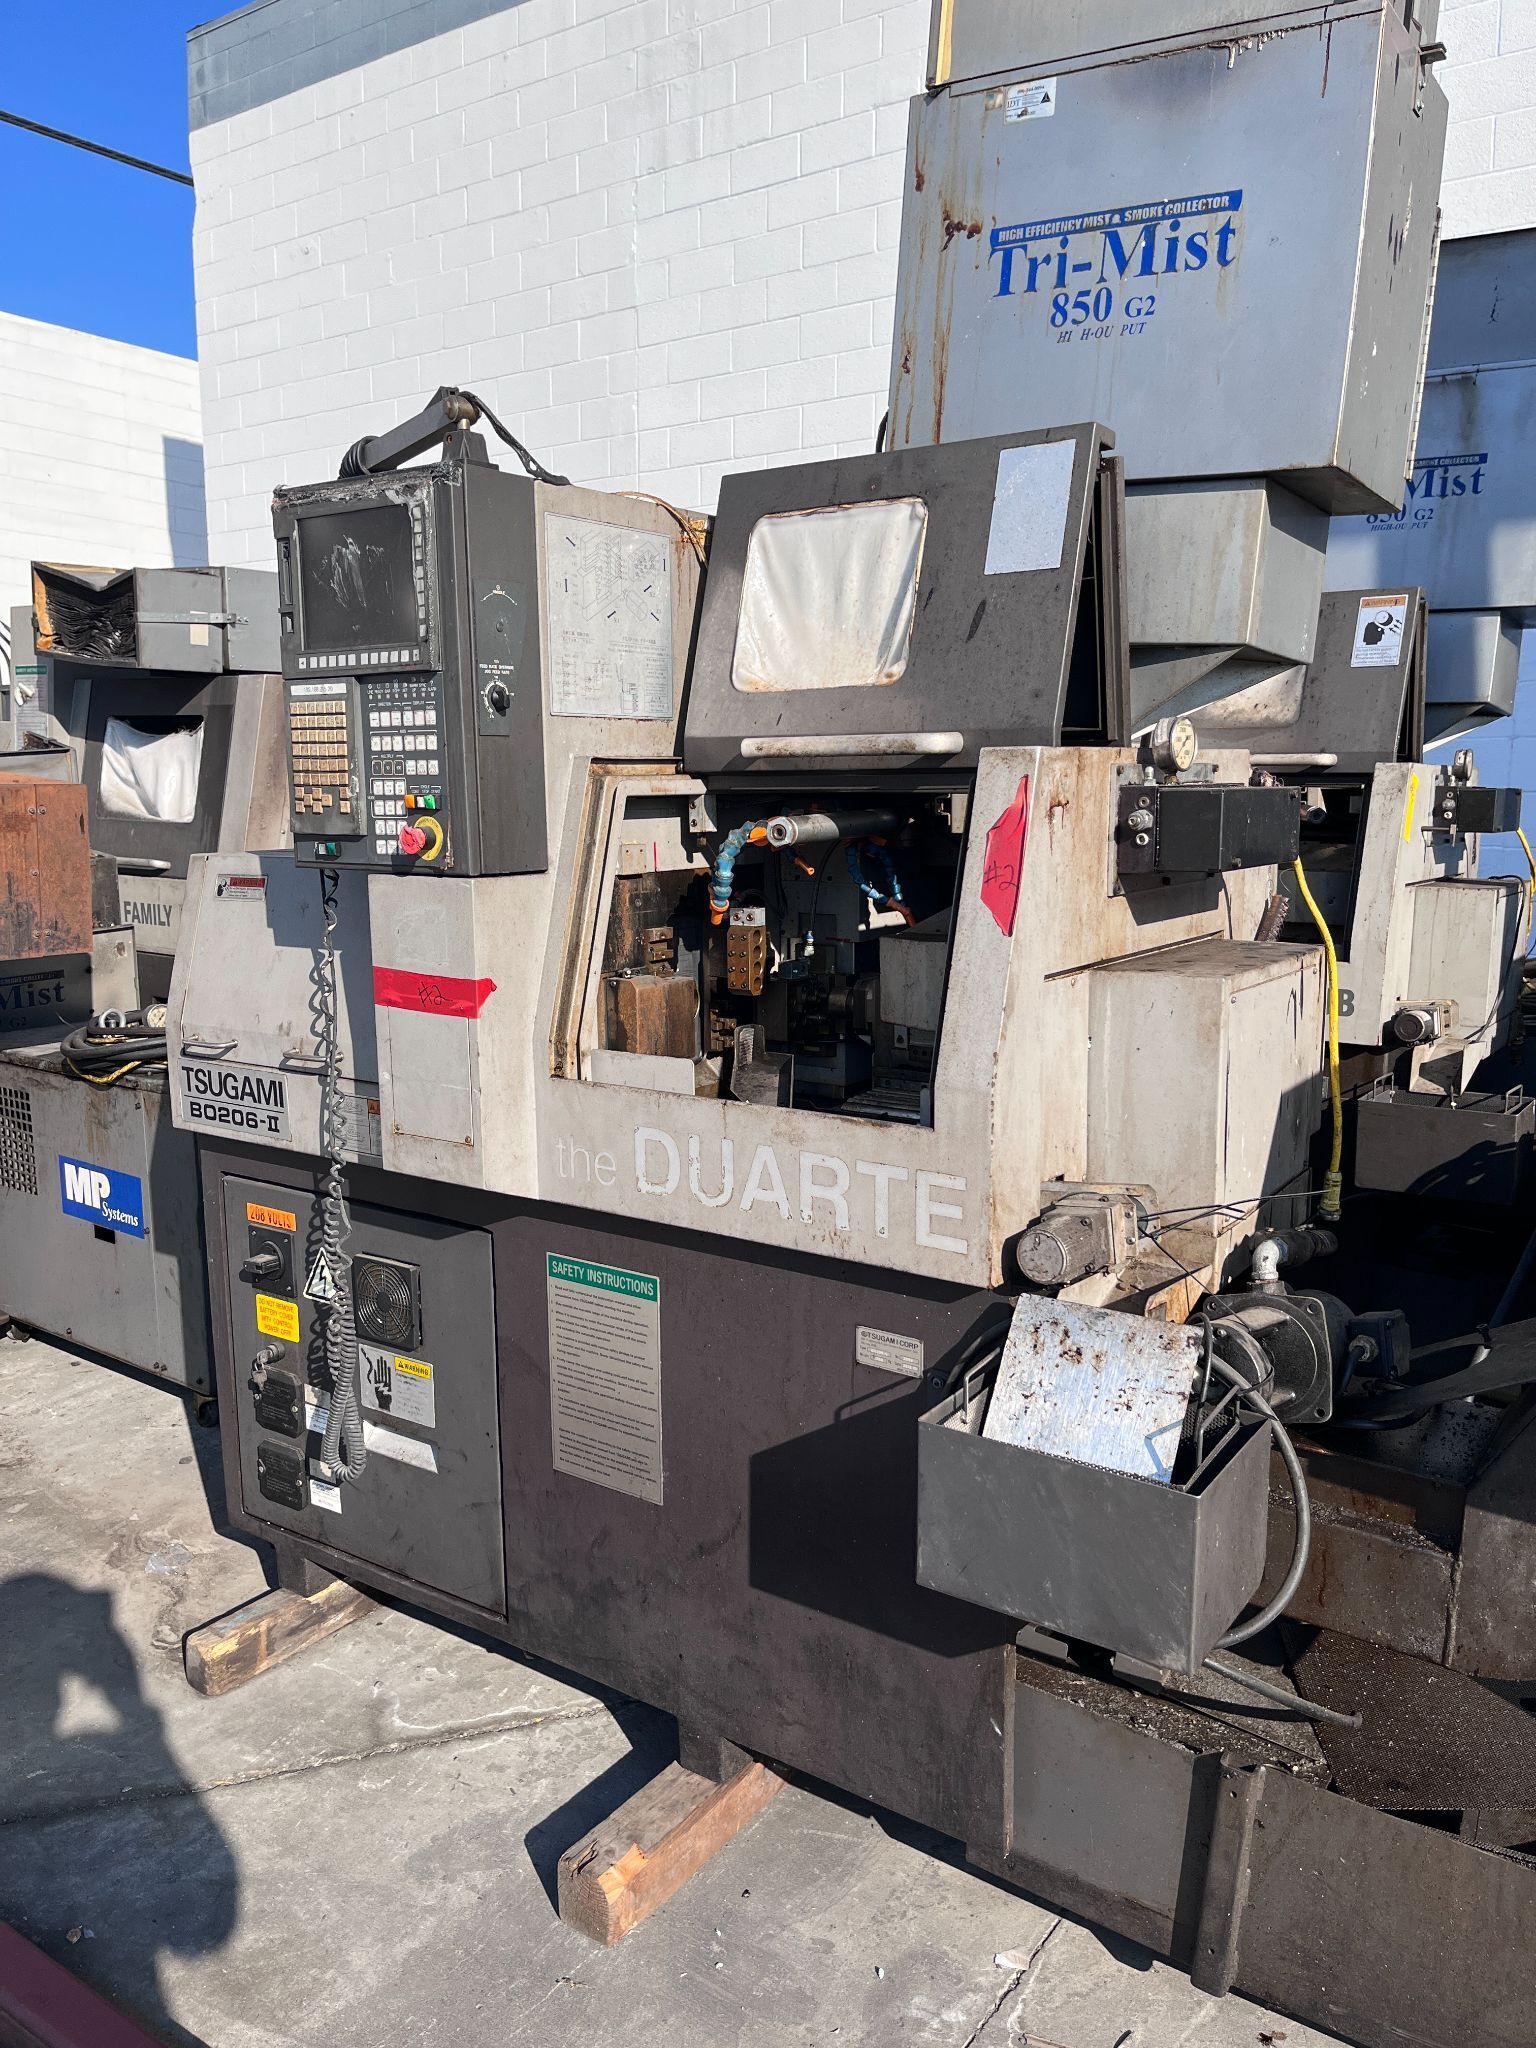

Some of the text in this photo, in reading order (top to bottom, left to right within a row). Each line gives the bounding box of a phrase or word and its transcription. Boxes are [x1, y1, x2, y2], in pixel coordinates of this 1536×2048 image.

[998, 228, 1024, 243] HIGH
[1025, 218, 1081, 237] EFFICIENCY
[1082, 214, 1111, 229] MIST
[1124, 206, 1164, 222] SMOKE
[1165, 195, 1230, 216] COLLECTOR
[987, 215, 1237, 299] Tri-Mist
[1050, 287, 1156, 328] 850 G2
[1414, 508, 1434, 521] G2
[123, 900, 173, 928] FAMILY
[181, 1066, 285, 1109] TSUGAMI
[64, 1162, 140, 1228] MP Systems
[555, 1125, 969, 1256] the DUARTE
[250, 1205, 293, 1230] 208 VOLTS
[551, 1260, 585, 1280] SAFETY
[586, 1268, 655, 1297] INSTRUCTIONS
[867, 1331, 920, 1350] TSUGAMI CORP
[404, 1362, 430, 1377] WARNING
